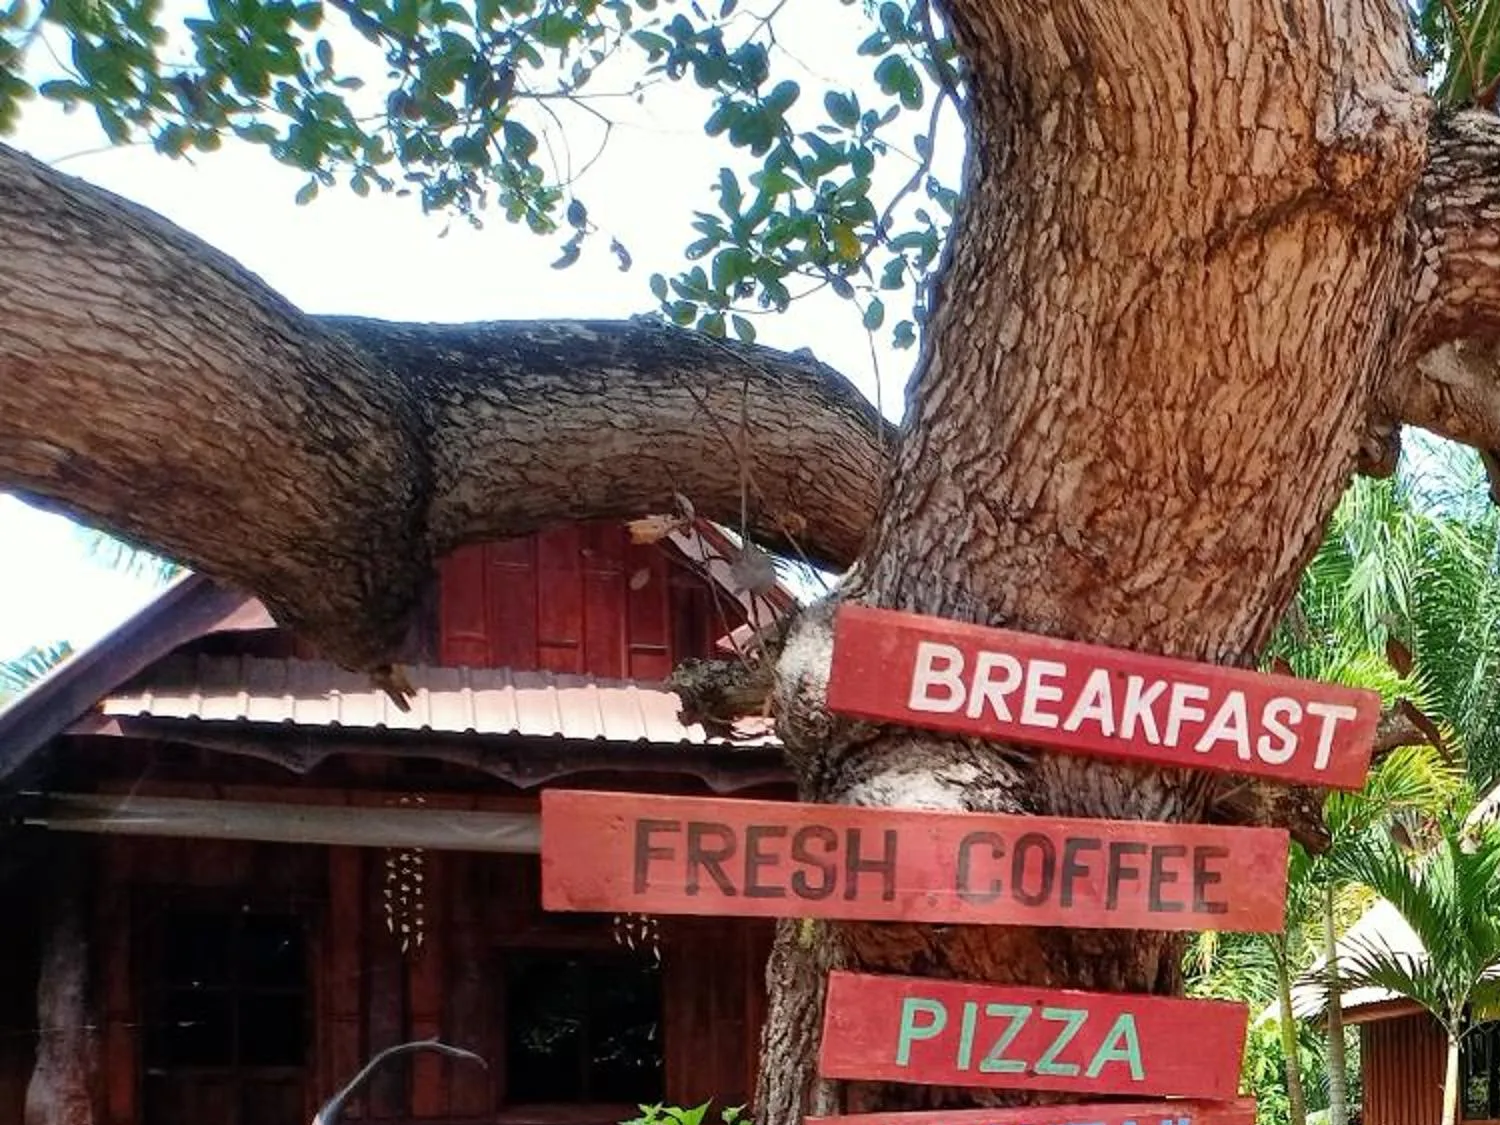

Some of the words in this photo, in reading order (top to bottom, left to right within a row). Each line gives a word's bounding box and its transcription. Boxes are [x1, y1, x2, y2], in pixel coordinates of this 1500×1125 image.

[907, 641, 1358, 771] BREAKFAST
[633, 818, 897, 902] FRESH
[955, 831, 1229, 914] COFFEE
[895, 997, 1146, 1081] PIZZA
